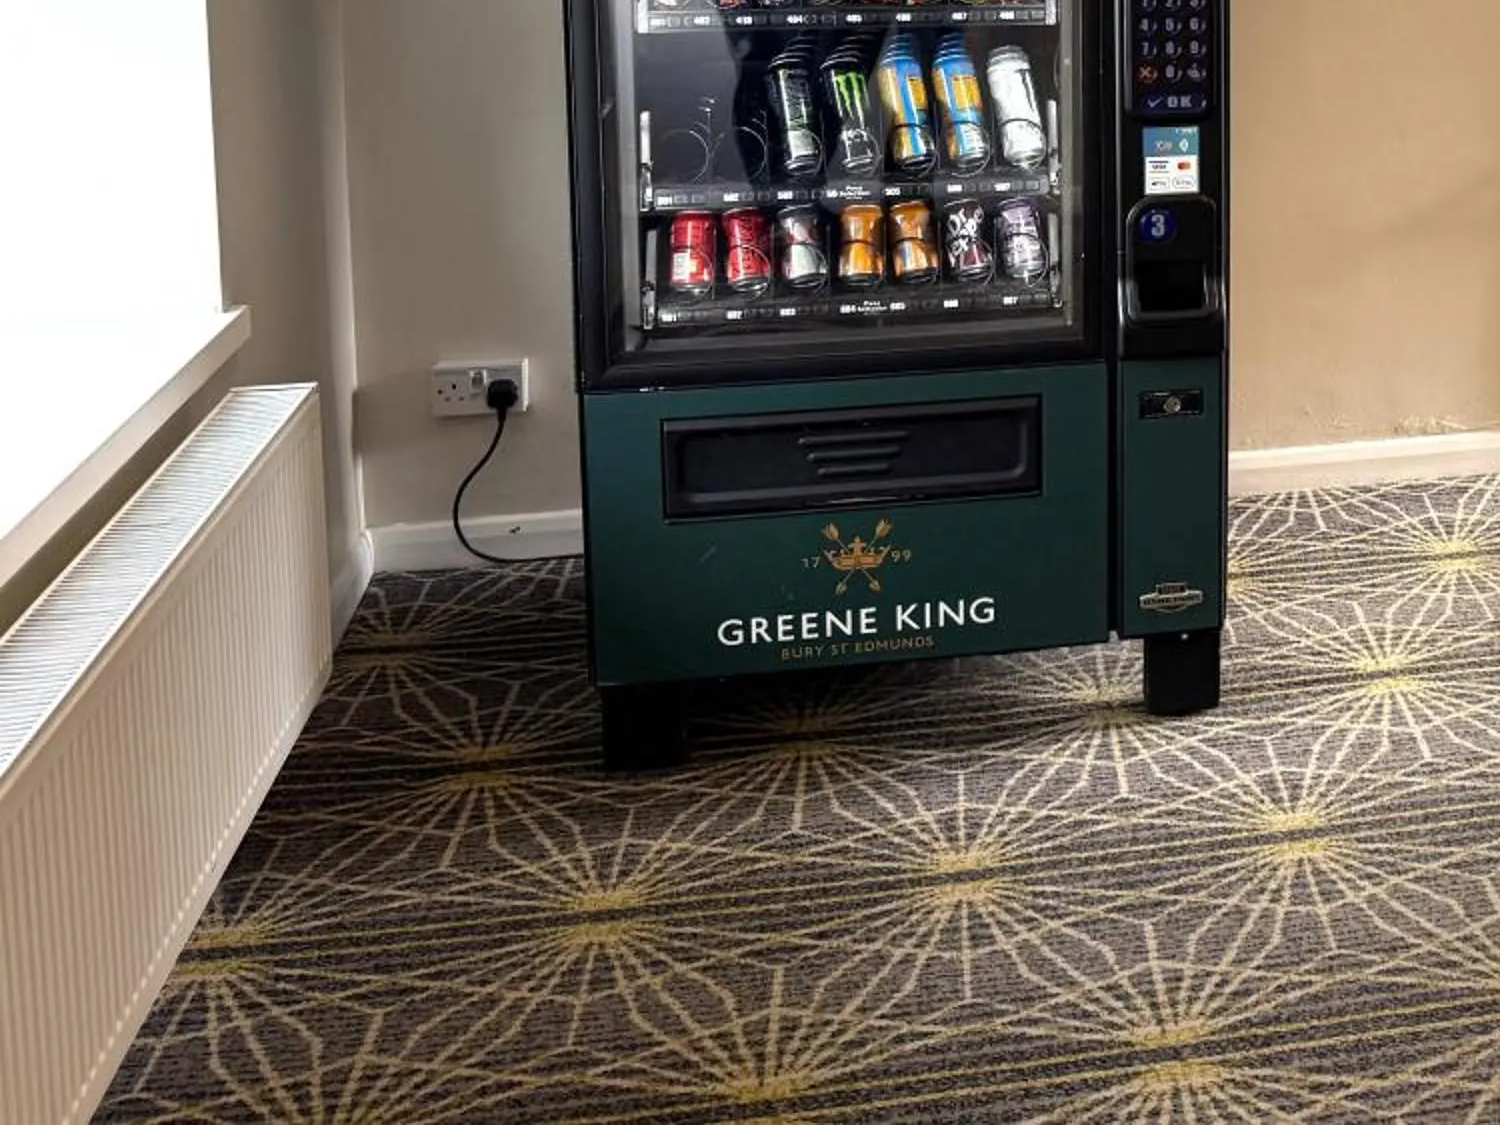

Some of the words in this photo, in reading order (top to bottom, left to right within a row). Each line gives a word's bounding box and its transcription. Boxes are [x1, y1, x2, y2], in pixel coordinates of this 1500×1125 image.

[1167, 95, 1192, 108] OK
[1150, 214, 1165, 238] 3
[801, 555, 822, 569] 17
[890, 549, 913, 564] 99
[717, 606, 878, 647] GREENE
[895, 596, 996, 632] KING
[781, 645, 825, 662] BURY
[830, 642, 850, 657] ST
[854, 635, 936, 654] EDMUNDS
